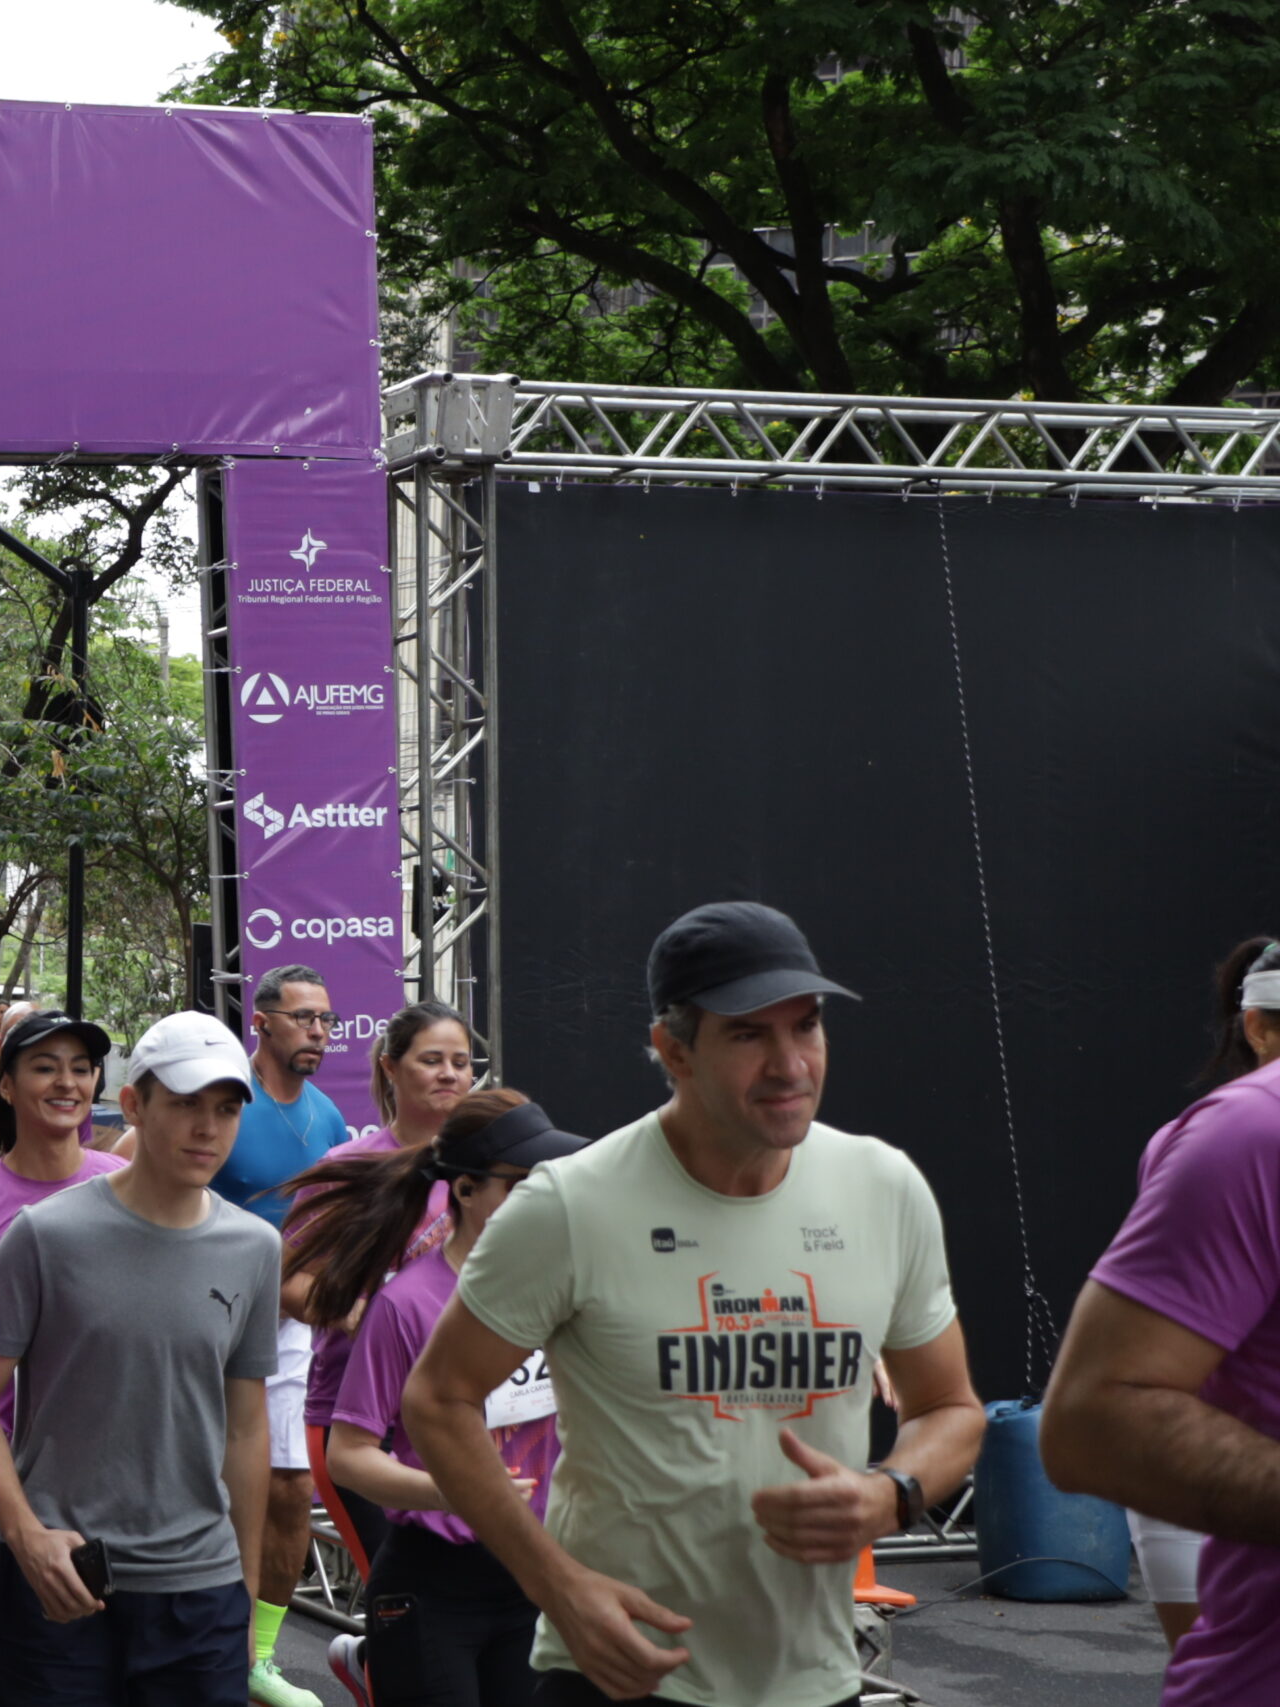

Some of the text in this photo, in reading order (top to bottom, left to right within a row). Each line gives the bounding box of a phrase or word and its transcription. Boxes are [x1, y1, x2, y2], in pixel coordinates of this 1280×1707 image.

[247, 578, 372, 594] JUSTIÇA FEDERAL
[237, 595, 269, 603] Tribunal
[270, 594, 304, 605] Regional
[305, 594, 333, 604] Federal
[334, 594, 344, 603] da
[357, 595, 383, 605] Região
[293, 684, 384, 711] AJUFEMG
[287, 803, 388, 829] Asttter
[290, 916, 395, 945] copasa
[800, 1227, 838, 1239] Track
[803, 1239, 845, 1252] & Field
[713, 1288, 805, 1315] IRONMAN
[715, 1315, 752, 1332] 70.3
[657, 1331, 863, 1393] FINISHER
